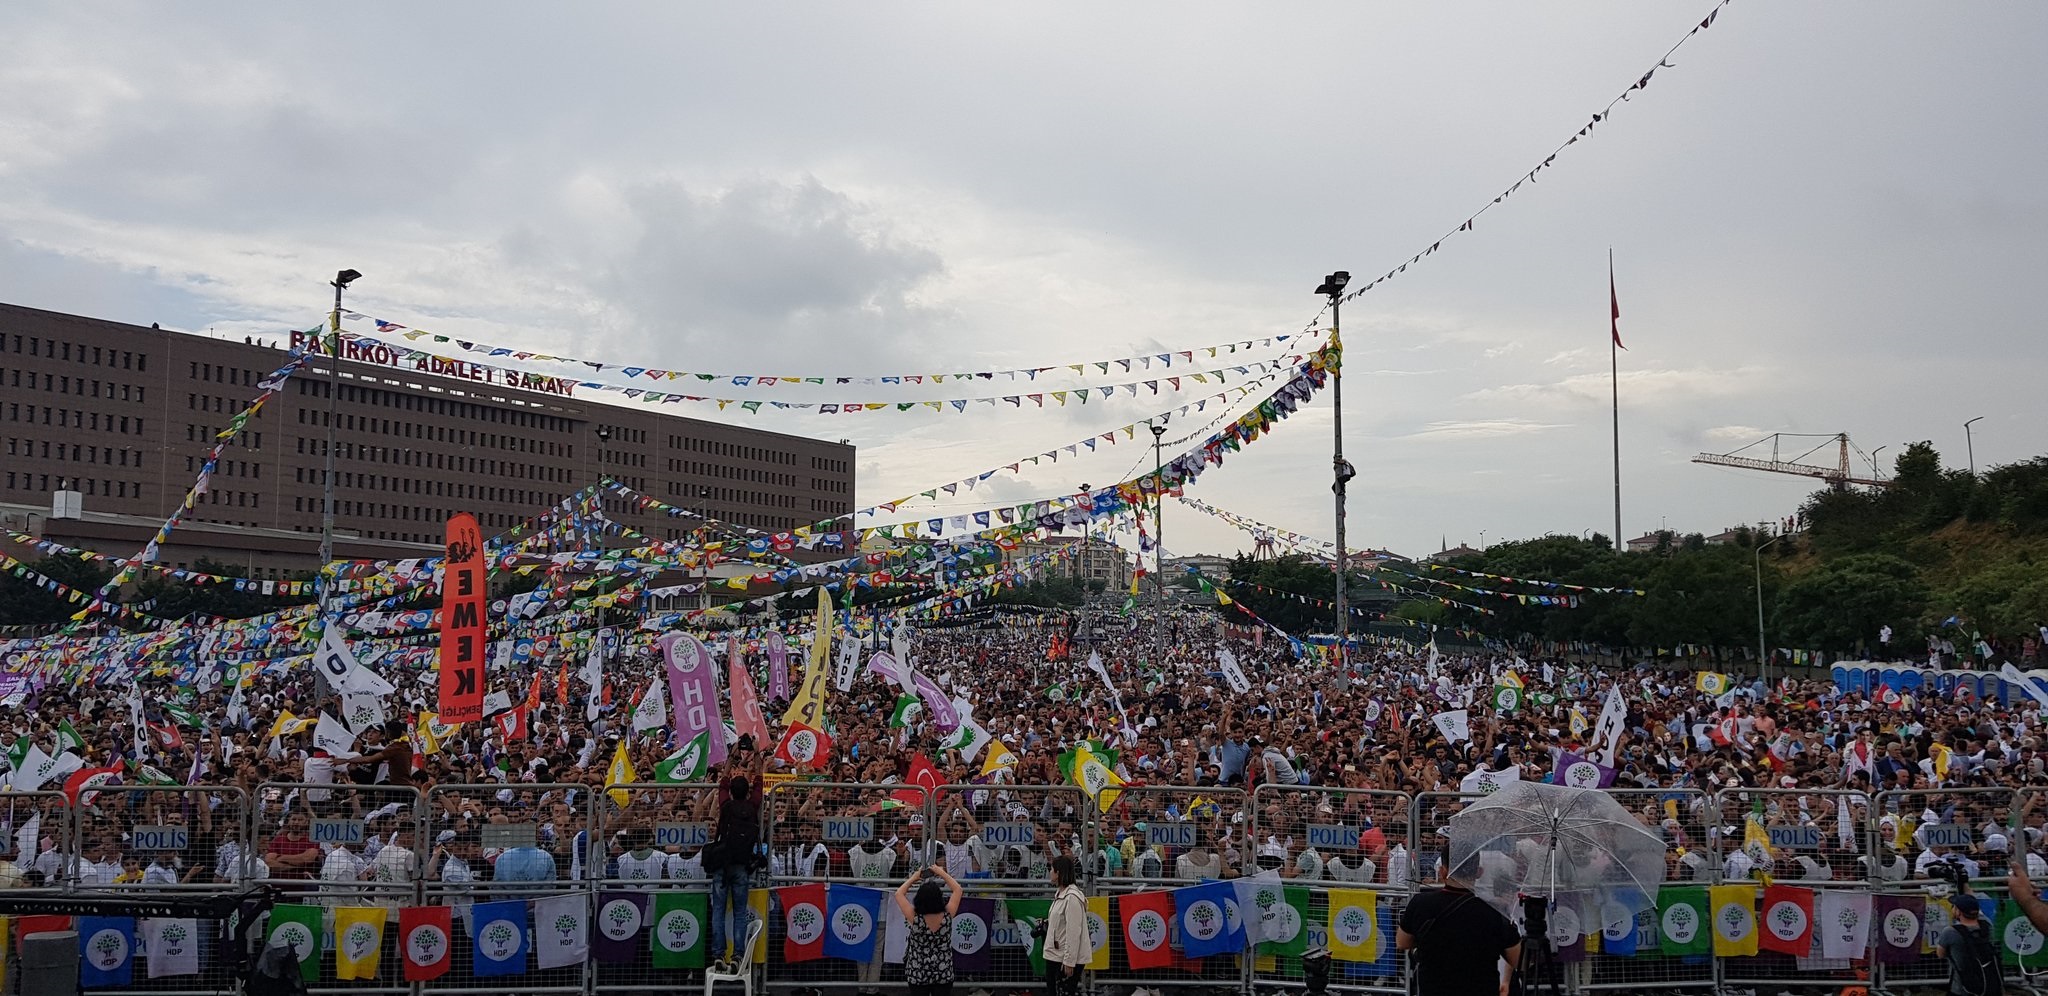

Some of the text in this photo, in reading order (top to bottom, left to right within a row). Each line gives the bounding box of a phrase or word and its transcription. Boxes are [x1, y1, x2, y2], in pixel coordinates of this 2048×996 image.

[290, 330, 573, 396] BAIRKÖY ADALET SARAY
[840, 654, 852, 687] HDP
[135, 828, 186, 848] POLİS
[315, 820, 359, 842] POLİS
[656, 825, 707, 844] POLİS
[829, 819, 869, 839] POLİS
[985, 823, 1033, 843] POLİS
[1152, 825, 1191, 844] POLİS
[1310, 828, 1358, 846] POLİS
[1771, 827, 1818, 846] POLİS
[1927, 827, 1970, 844] POLİS
[1262, 913, 1276, 921] HDP
[797, 933, 812, 941] HDP
[842, 933, 857, 941] HDP
[1199, 929, 1213, 937] HDP
[418, 954, 434, 962] HDP
[493, 949, 508, 957] HDP
[101, 958, 118, 967] HDP
